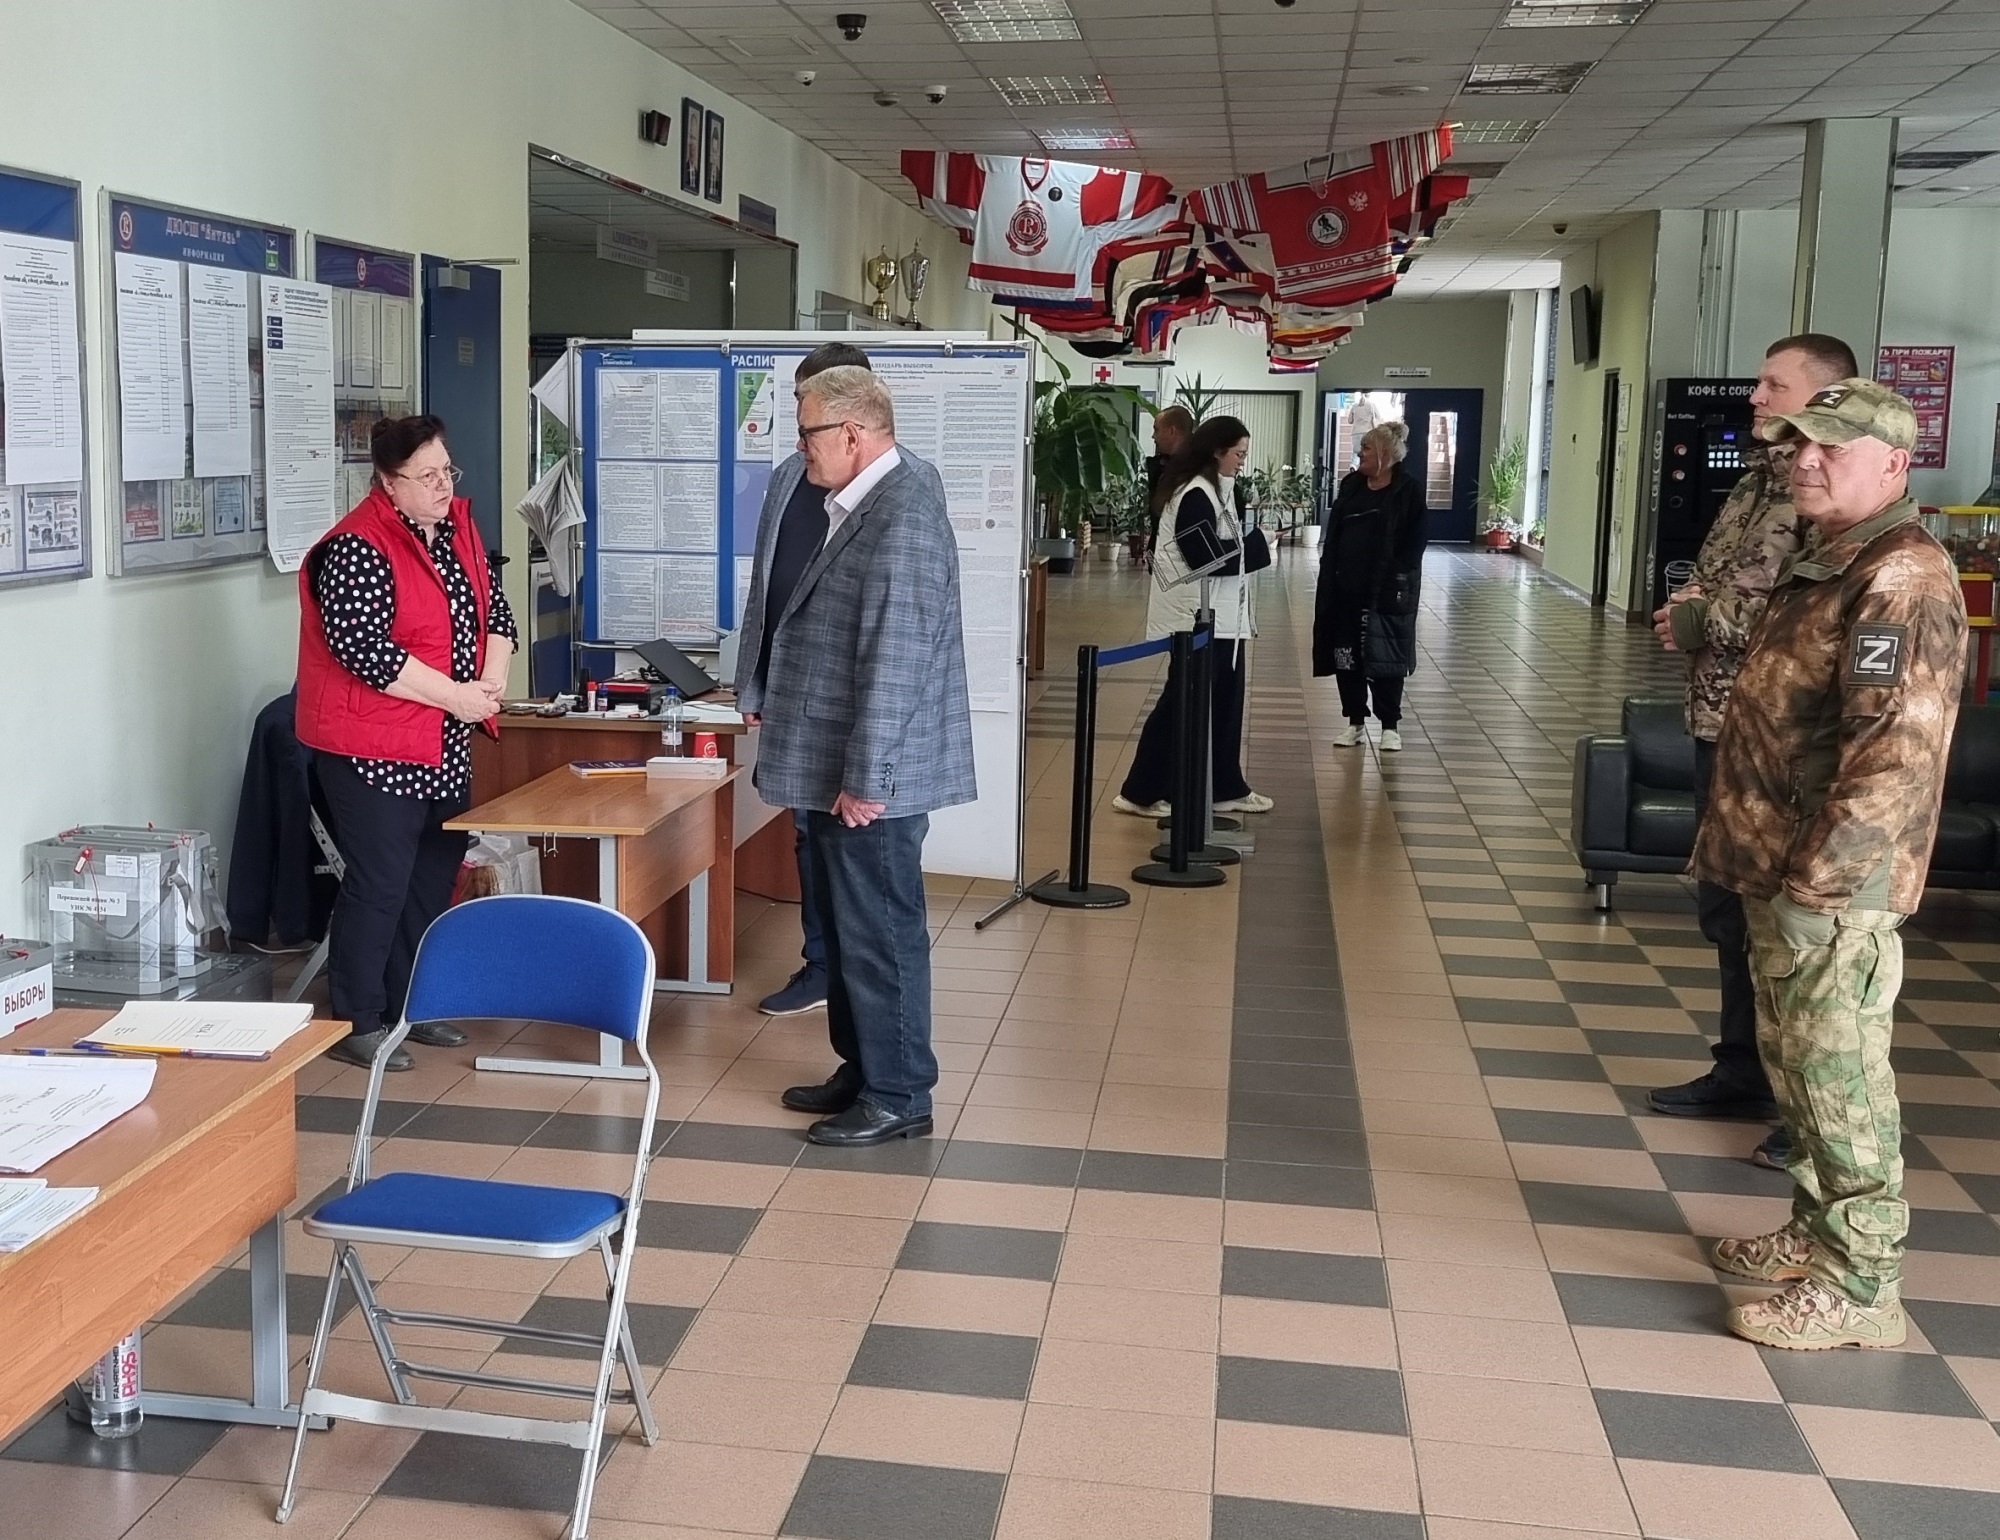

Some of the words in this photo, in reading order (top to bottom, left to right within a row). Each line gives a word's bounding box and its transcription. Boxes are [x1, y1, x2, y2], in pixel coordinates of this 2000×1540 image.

[165, 216, 200, 237] ДЮСШ
[182, 247, 225, 262] ИНФОРМАЦИЯ
[1309, 257, 1355, 273] RUSSIA
[1891, 348, 1910, 356] ПРИ
[1687, 385, 1717, 396] КОФЕ
[1719, 385, 1726, 396] С
[1822, 392, 1842, 405] Z
[1860, 639, 1891, 670] Z
[4, 982, 46, 1015] ВЫБОРЫ
